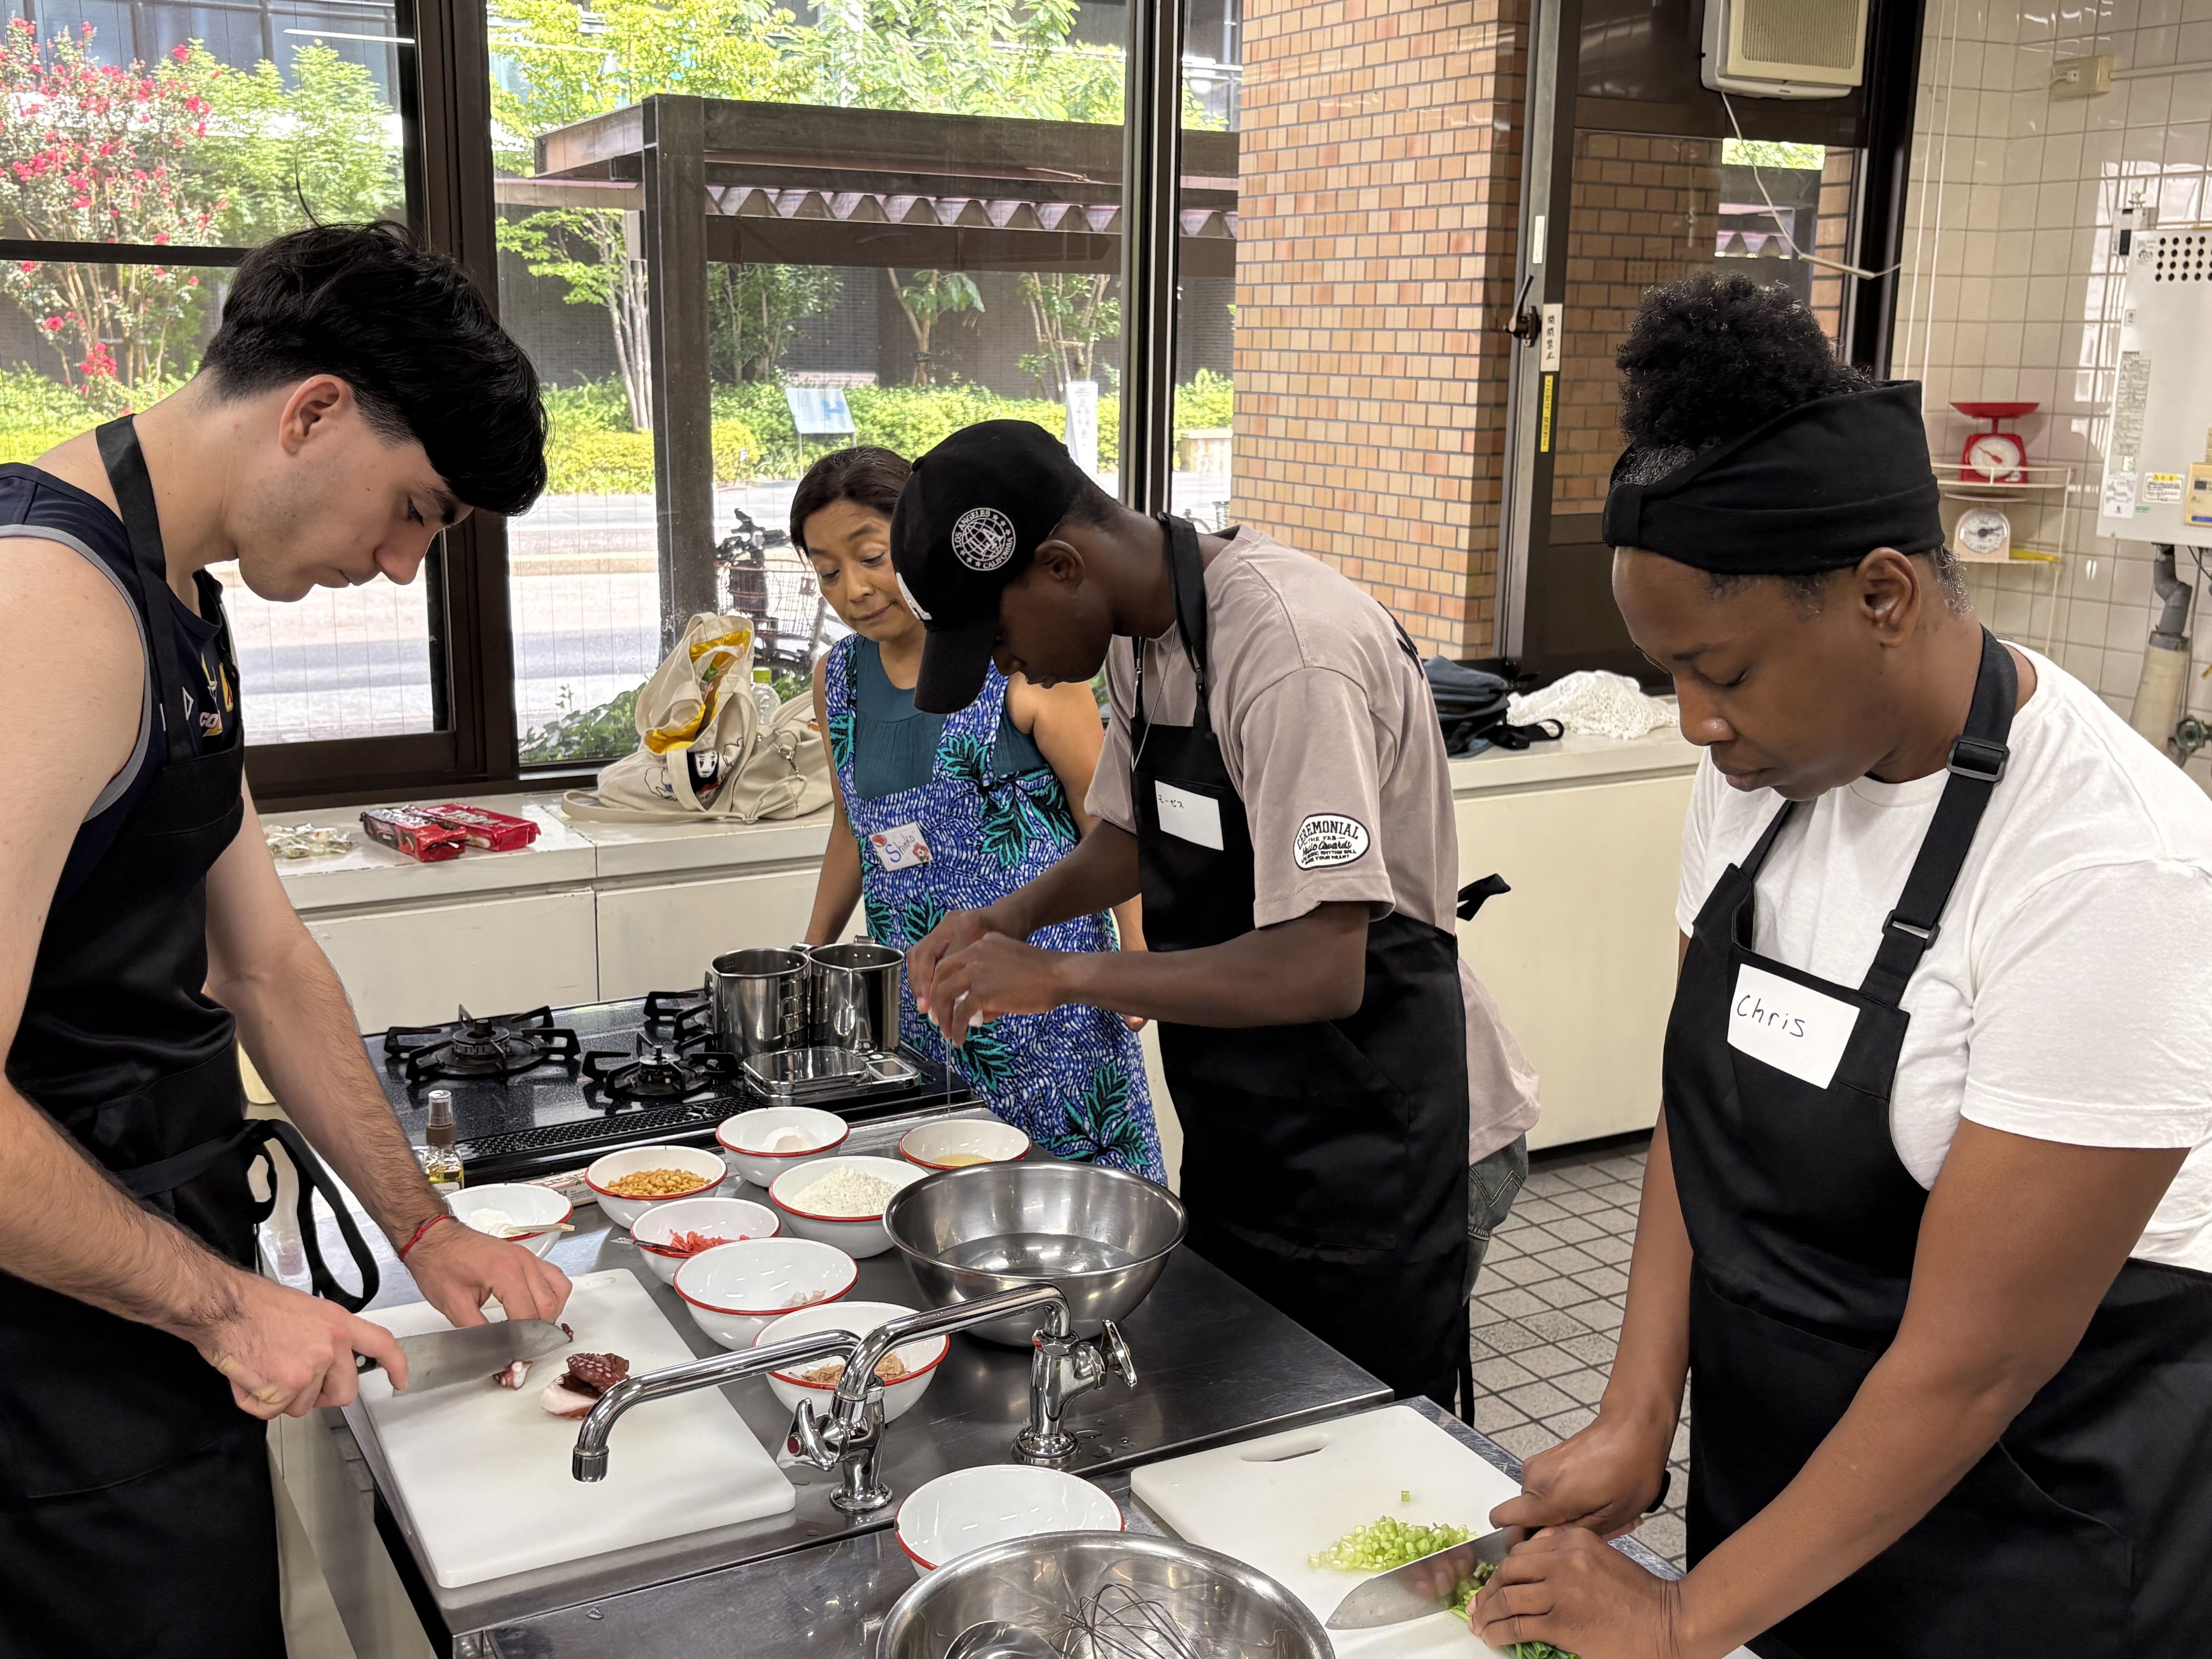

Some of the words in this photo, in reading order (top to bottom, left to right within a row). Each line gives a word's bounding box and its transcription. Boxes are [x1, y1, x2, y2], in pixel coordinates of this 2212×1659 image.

[958, 510, 991, 531] ANGELES
[982, 537, 1013, 569] CALIFORNIA
[885, 833, 915, 863] Shinko
[1297, 820, 1358, 850] CEREMONIAL
[1736, 994, 1805, 1037] Chris
